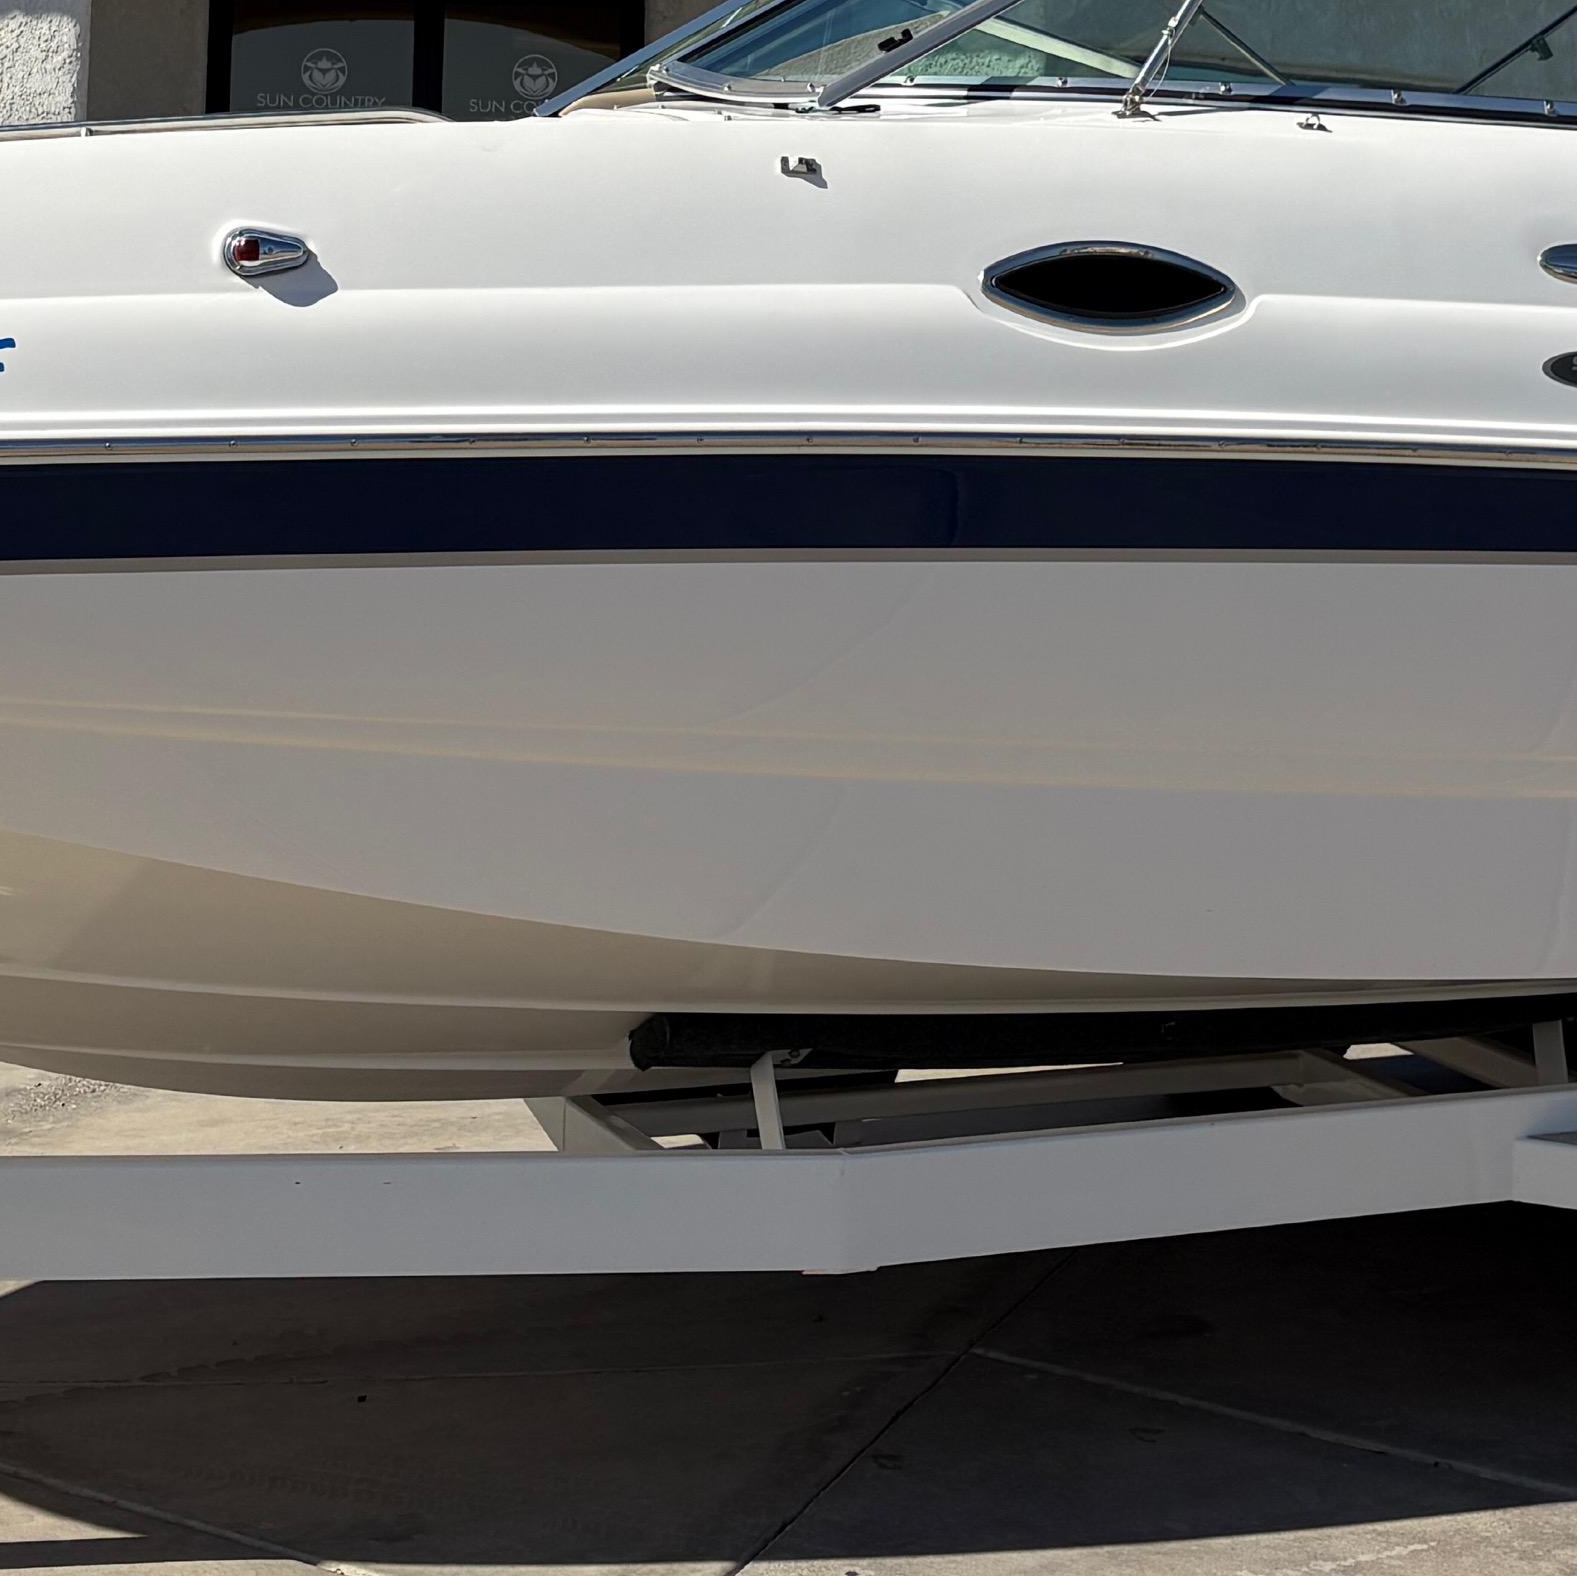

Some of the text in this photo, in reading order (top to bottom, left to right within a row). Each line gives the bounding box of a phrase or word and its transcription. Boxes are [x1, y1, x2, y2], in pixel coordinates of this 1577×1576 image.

[256, 93, 387, 109] SUN COUNTRY
[469, 98, 505, 113] SUN
